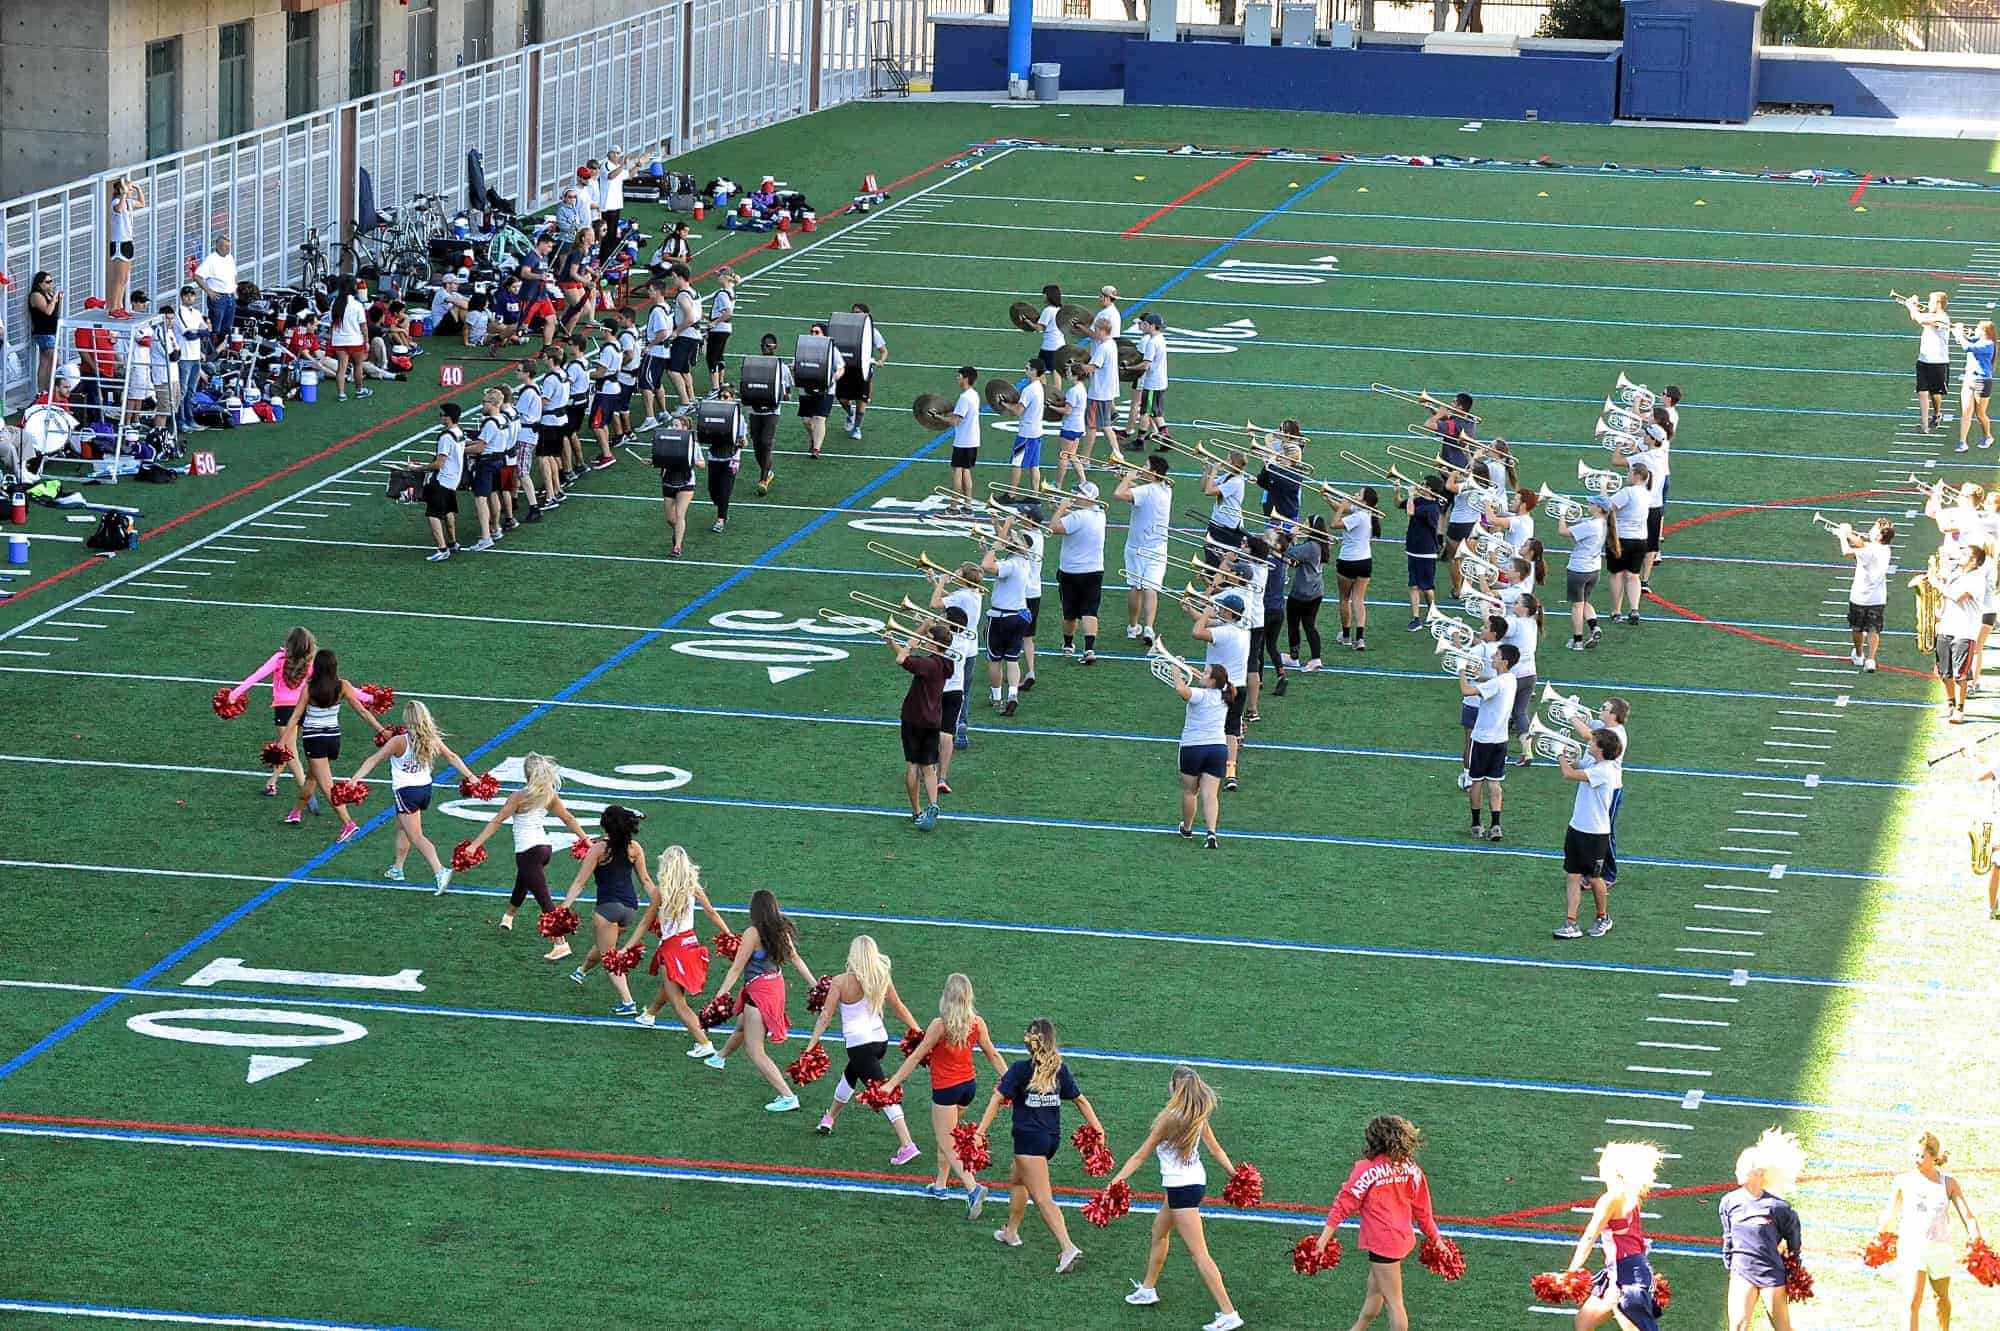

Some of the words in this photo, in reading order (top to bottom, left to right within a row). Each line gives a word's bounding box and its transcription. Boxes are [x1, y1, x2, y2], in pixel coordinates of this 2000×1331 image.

[442, 367, 462, 385] 40
[196, 453, 216, 474] 50
[669, 609, 886, 662] 30
[437, 756, 693, 827] 20
[126, 957, 428, 1048] 10
[1350, 1162, 1394, 1199] ARIZONA
